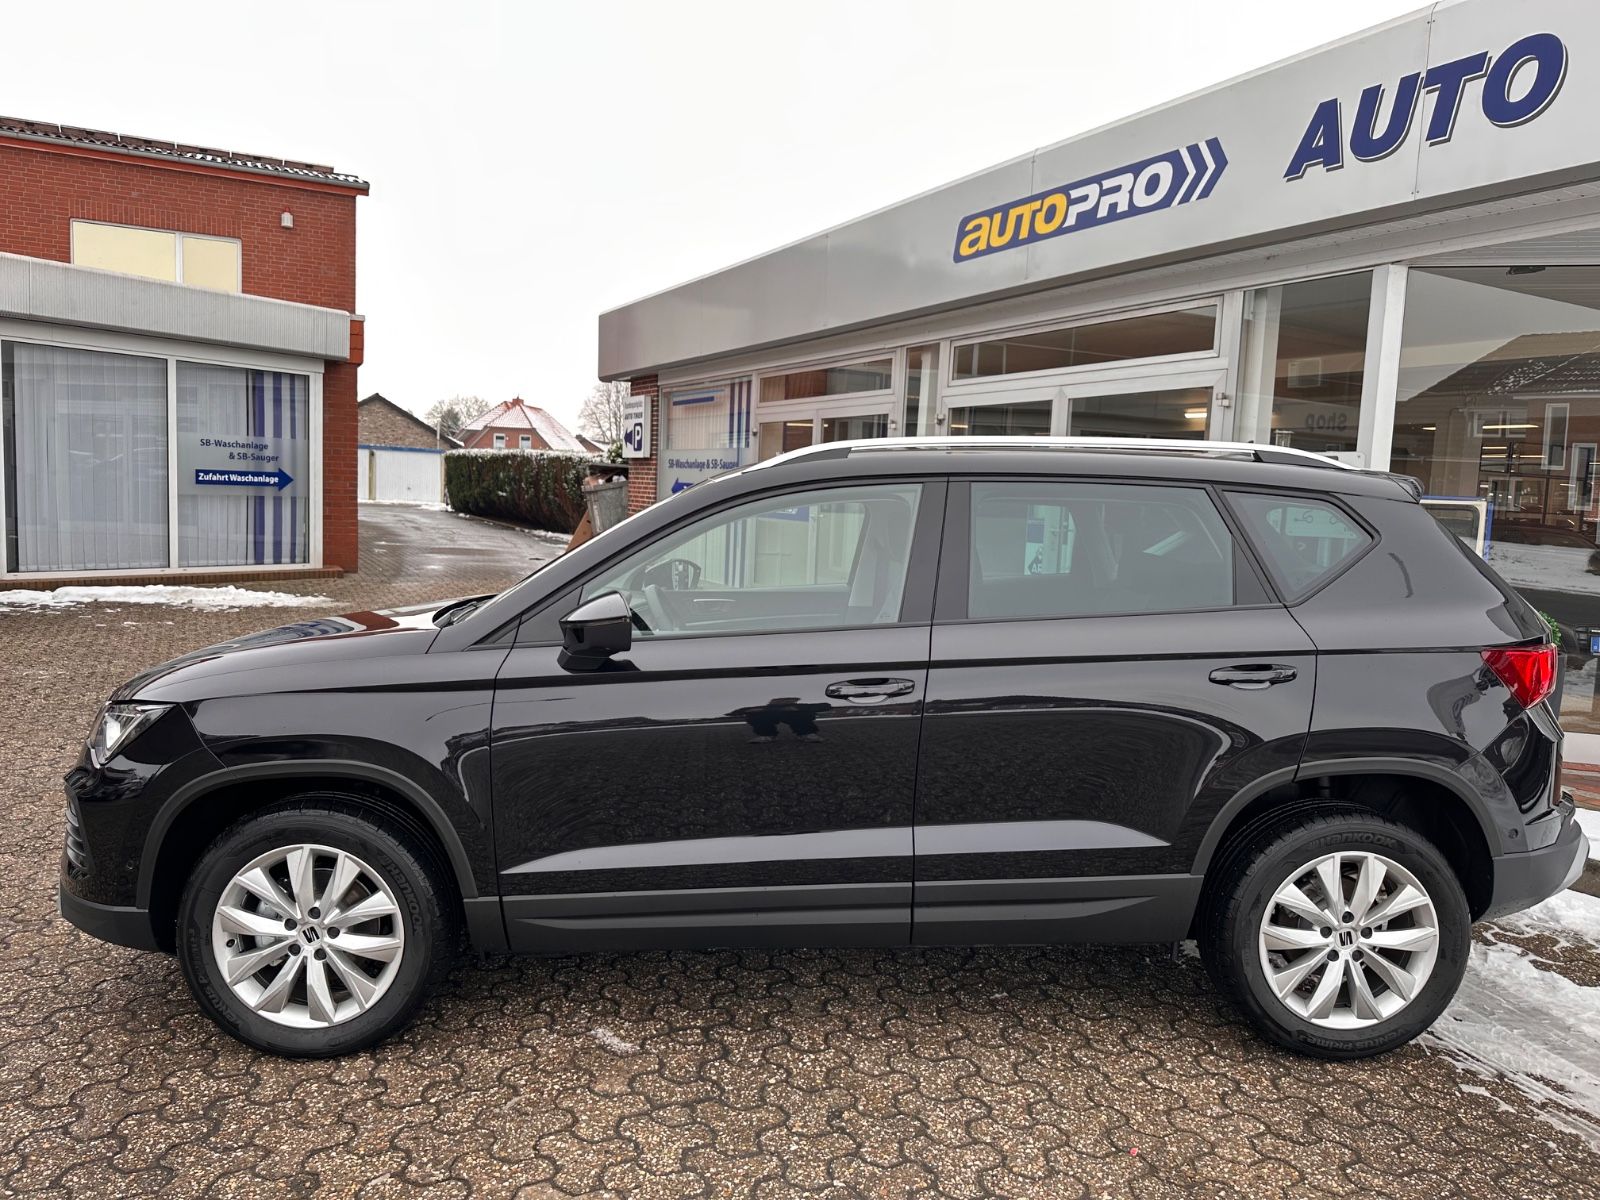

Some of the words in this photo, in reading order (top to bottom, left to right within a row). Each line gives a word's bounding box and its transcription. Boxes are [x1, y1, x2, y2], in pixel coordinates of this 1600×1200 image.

[1284, 33, 1568, 182] AUTO
[200, 438, 269, 451] SB-Waschanlage
[228, 452, 235, 460] &
[236, 452, 279, 463] SB-Sauger
[705, 458, 711, 469] &
[198, 472, 229, 482] Zufahrt
[229, 473, 279, 485] Waschanlage
